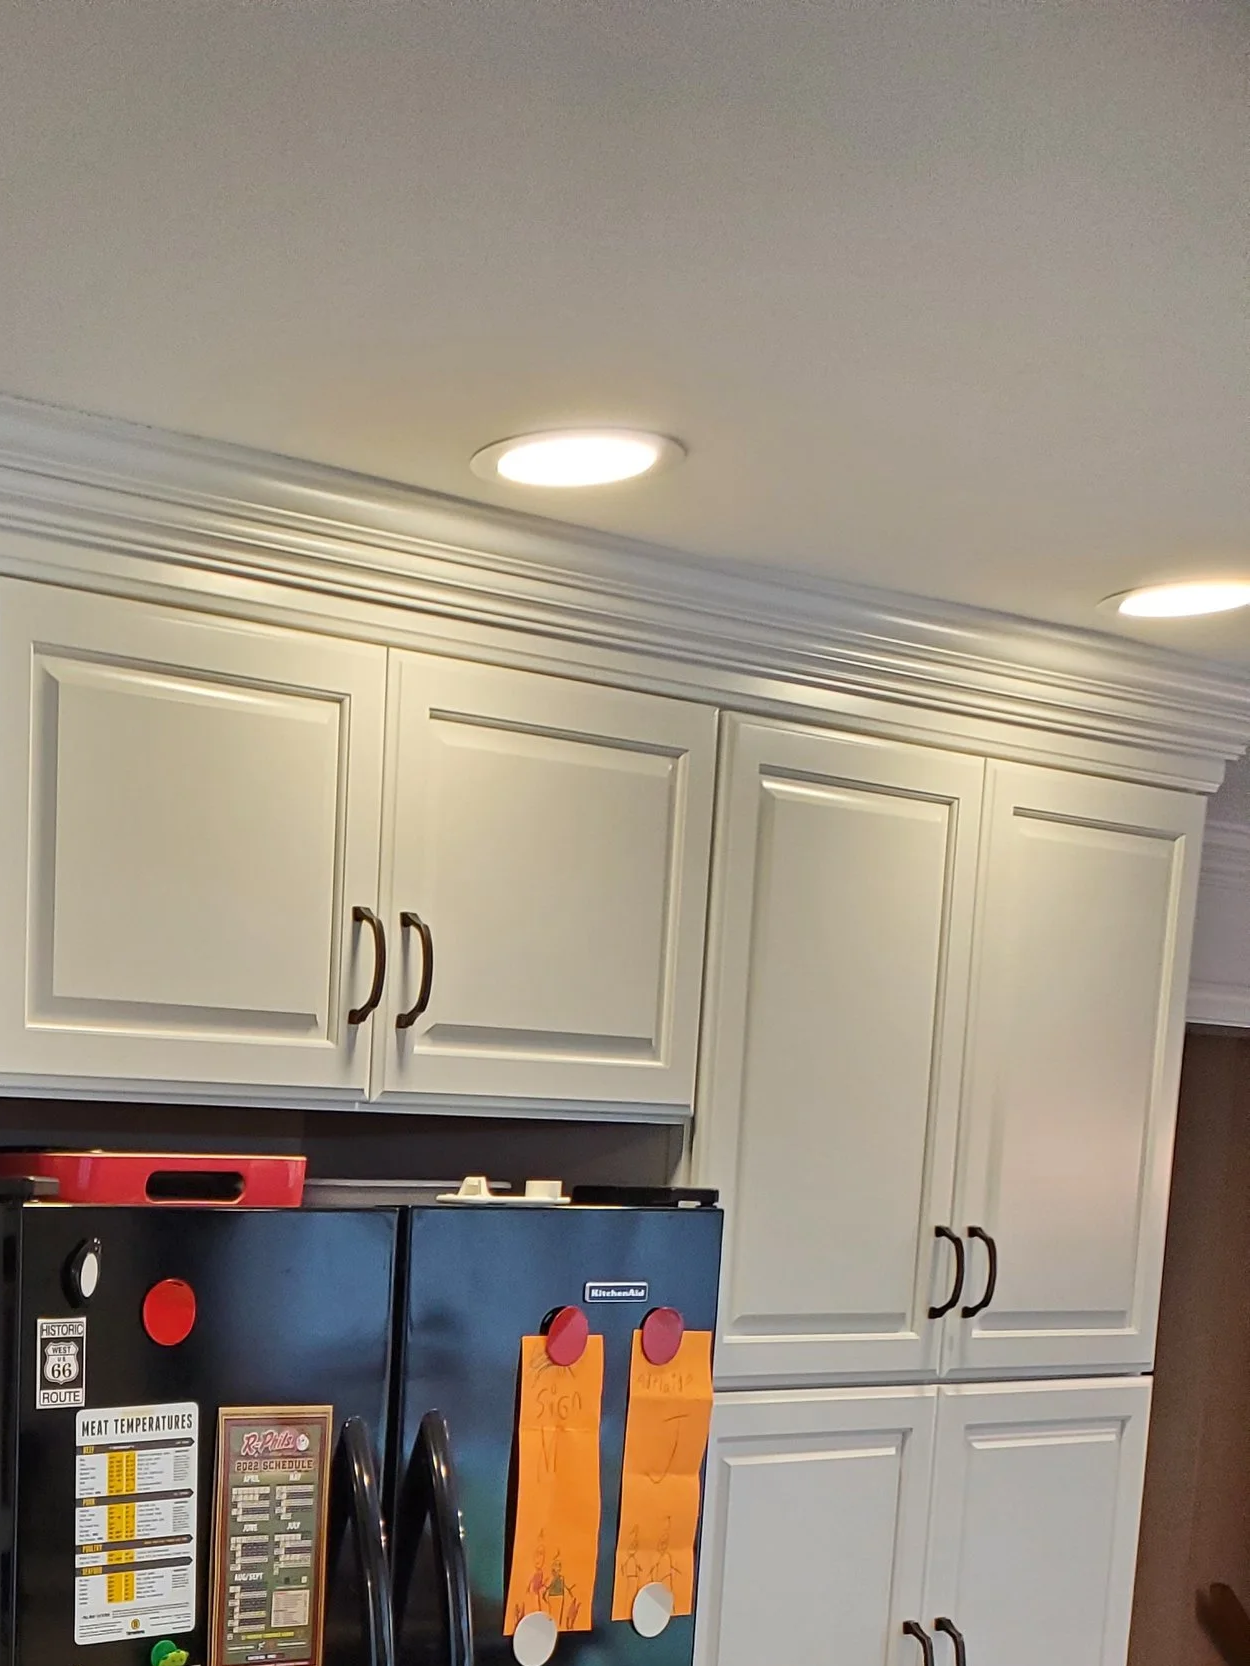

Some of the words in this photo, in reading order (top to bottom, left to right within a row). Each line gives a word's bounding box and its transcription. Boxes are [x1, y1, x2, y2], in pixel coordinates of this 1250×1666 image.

[590, 1288, 645, 1297] KitchenAid
[41, 1323, 84, 1337] HISTORIC
[51, 1346, 71, 1354] WEST
[51, 1363, 72, 1379] 66
[42, 1390, 81, 1404] ROUTE
[81, 1420, 109, 1437] MEAT
[114, 1413, 193, 1435] TEMPERATURES
[236, 1460, 259, 1472] 2022
[262, 1458, 314, 1470] SCHEDULE
[243, 1474, 260, 1483] APRIL
[288, 1473, 302, 1481] MAY
[242, 1523, 258, 1532] JUNE
[286, 1522, 301, 1531] JULY
[234, 1572, 264, 1581] AUG/SEPT
